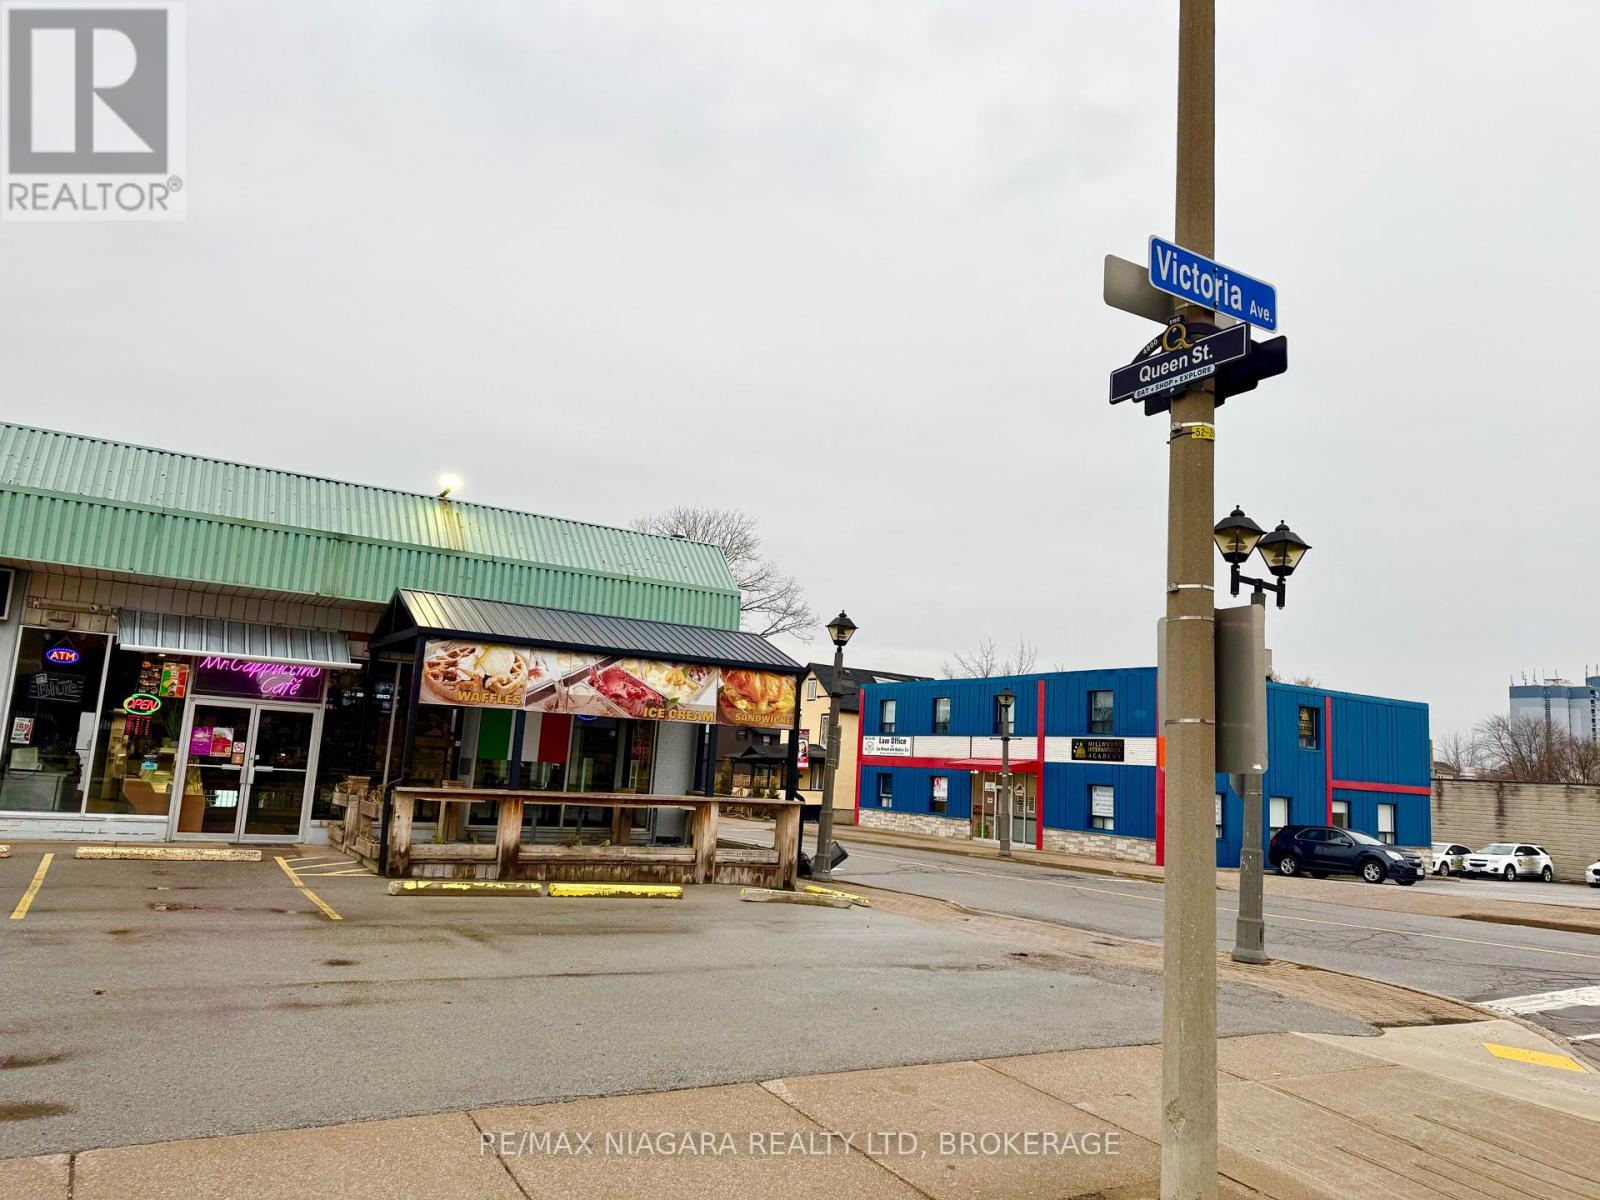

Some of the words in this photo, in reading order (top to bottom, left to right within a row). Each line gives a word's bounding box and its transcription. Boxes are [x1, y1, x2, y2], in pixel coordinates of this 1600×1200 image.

[1156, 245, 1242, 312] Victoria
[1249, 300, 1273, 323] Ave.
[1162, 323, 1195, 352] Q
[1140, 355, 1188, 383] Queen
[1192, 344, 1213, 364] St.
[1155, 379, 1173, 391] SHOP
[1179, 366, 1212, 382] EXPLORE
[50, 651, 76, 661] ATM
[260, 677, 303, 695] Café
[126, 697, 158, 711] OPEN
[457, 690, 521, 705] WAFFLES
[643, 707, 665, 719] ICE
[668, 709, 714, 722] CREAM
